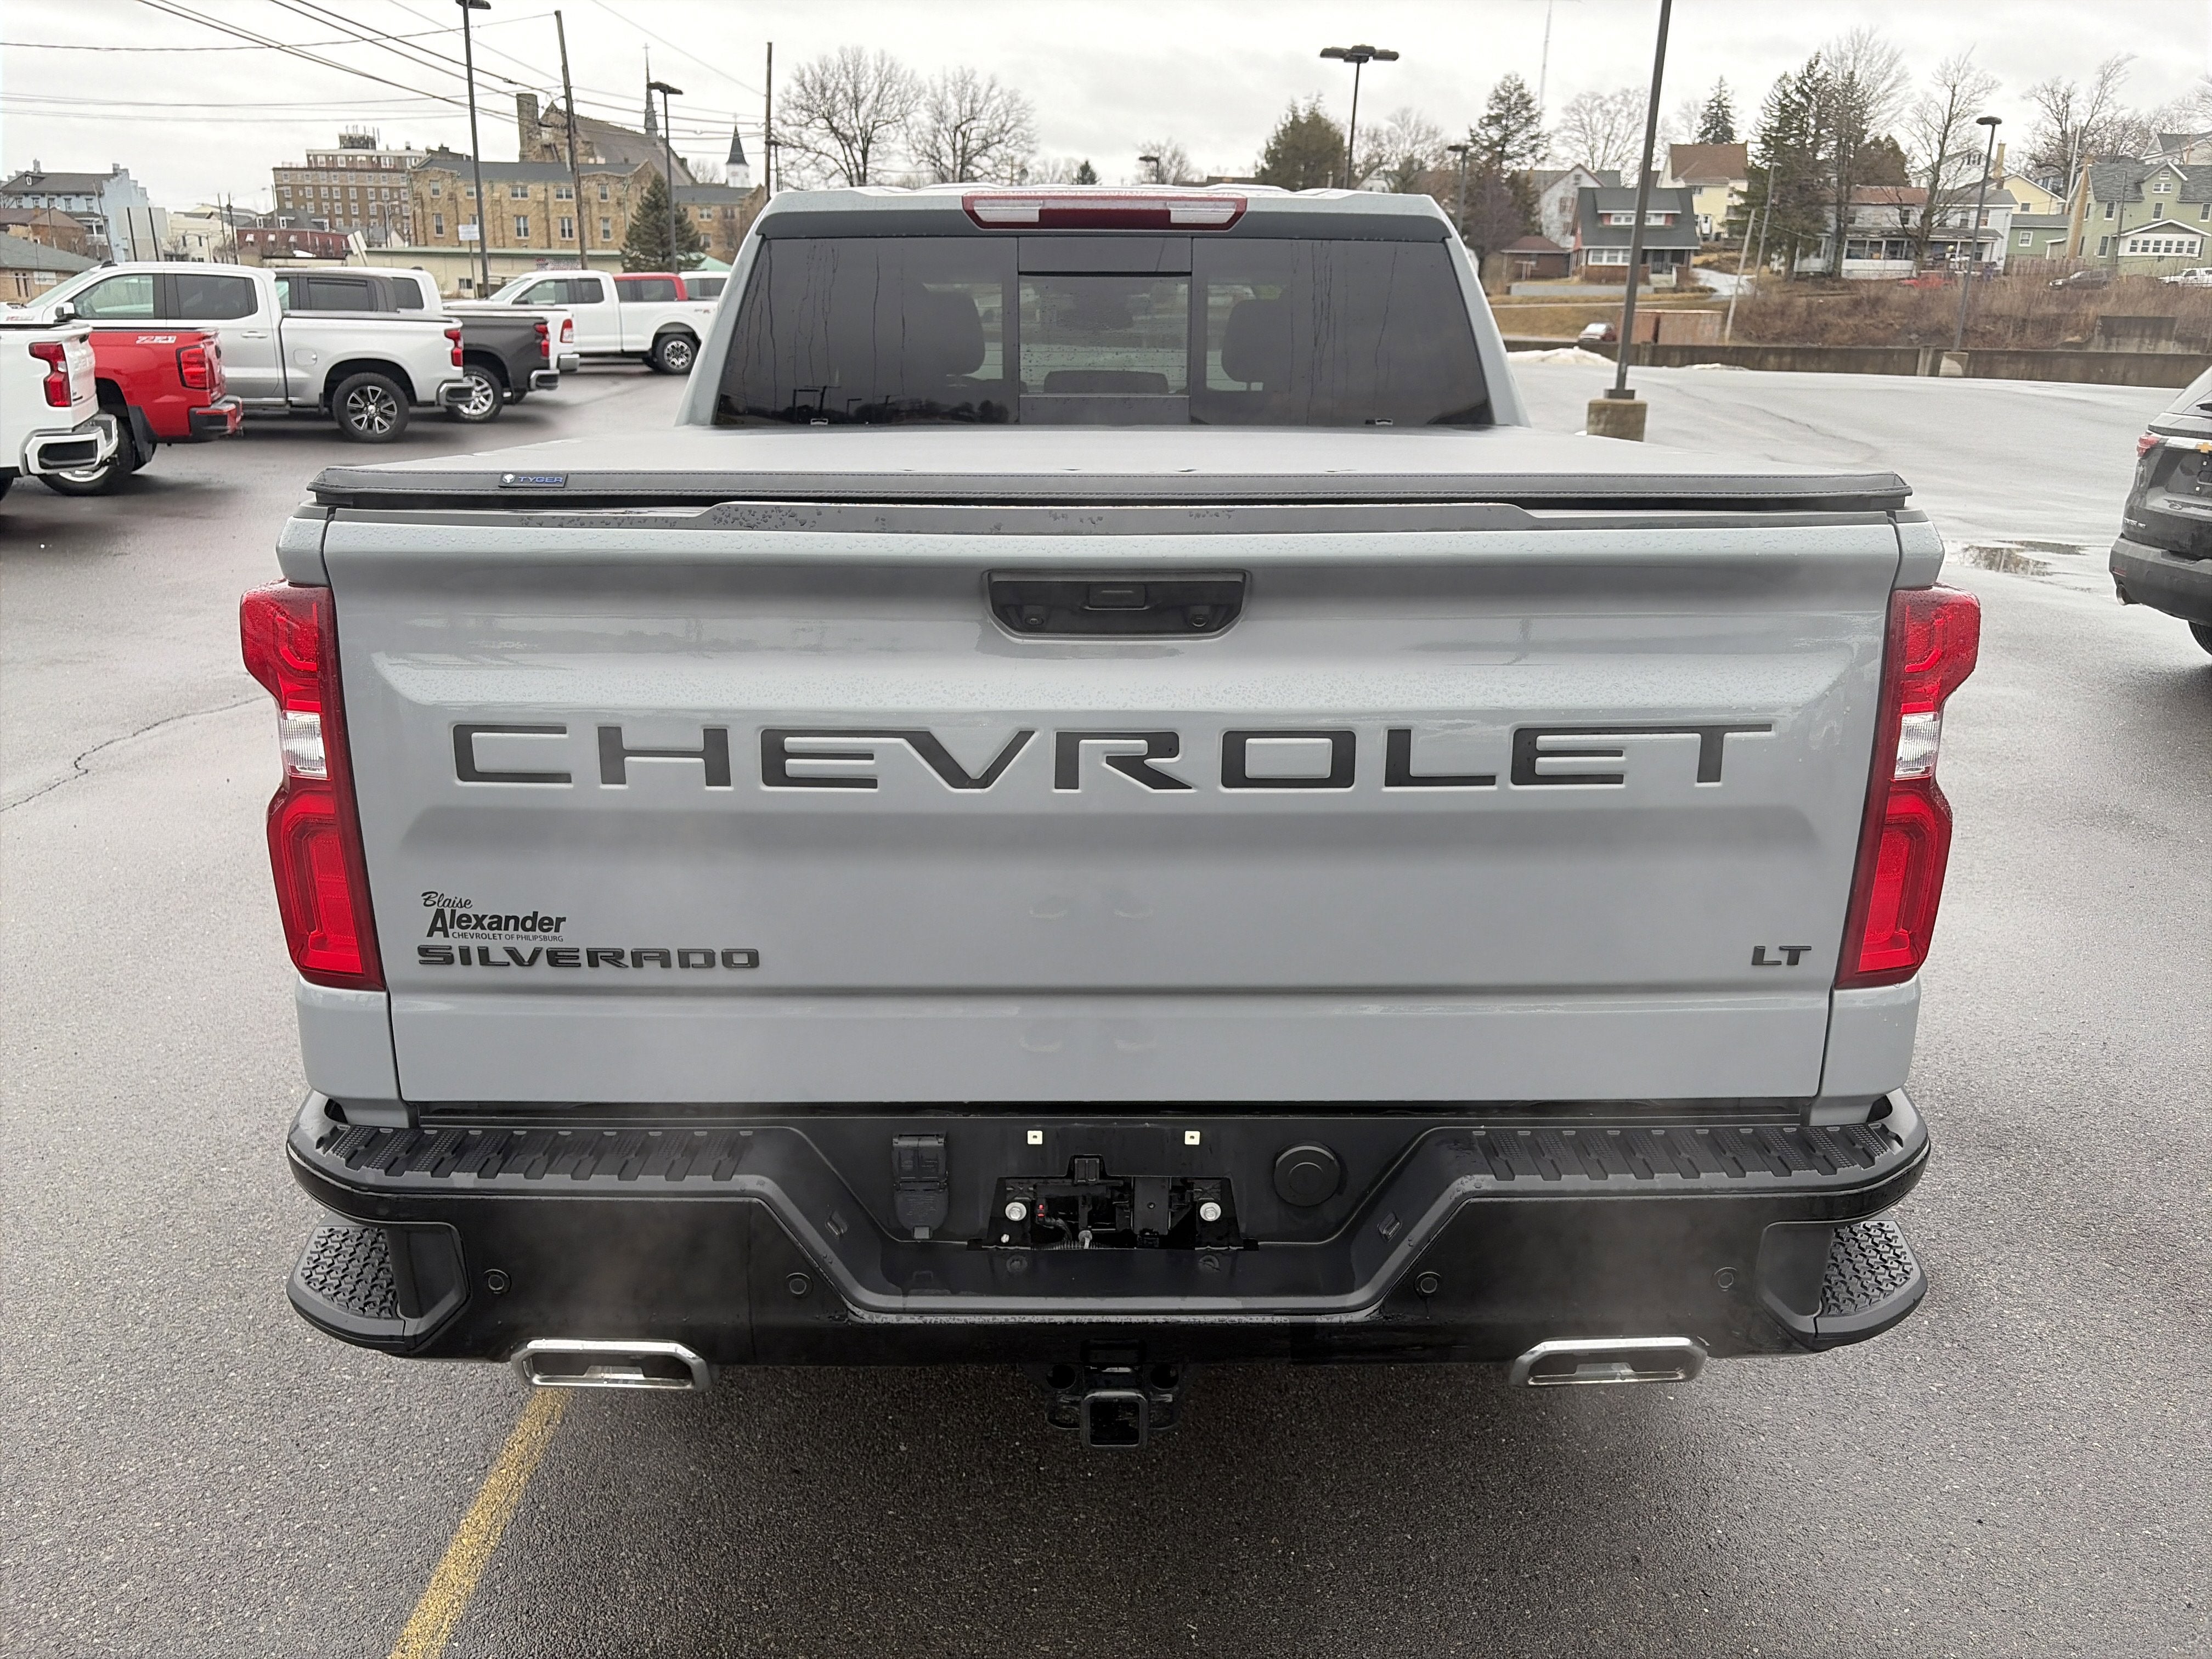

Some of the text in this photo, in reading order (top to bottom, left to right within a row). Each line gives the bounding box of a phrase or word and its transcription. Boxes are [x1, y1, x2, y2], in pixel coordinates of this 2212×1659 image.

[453, 723, 1773, 792] CHEVROLET
[421, 891, 473, 909] Blaise
[426, 908, 567, 938] Alexander
[452, 932, 503, 940] CHEVROLET
[417, 944, 760, 969] SILVERADO
[1752, 946, 1812, 966] LT
